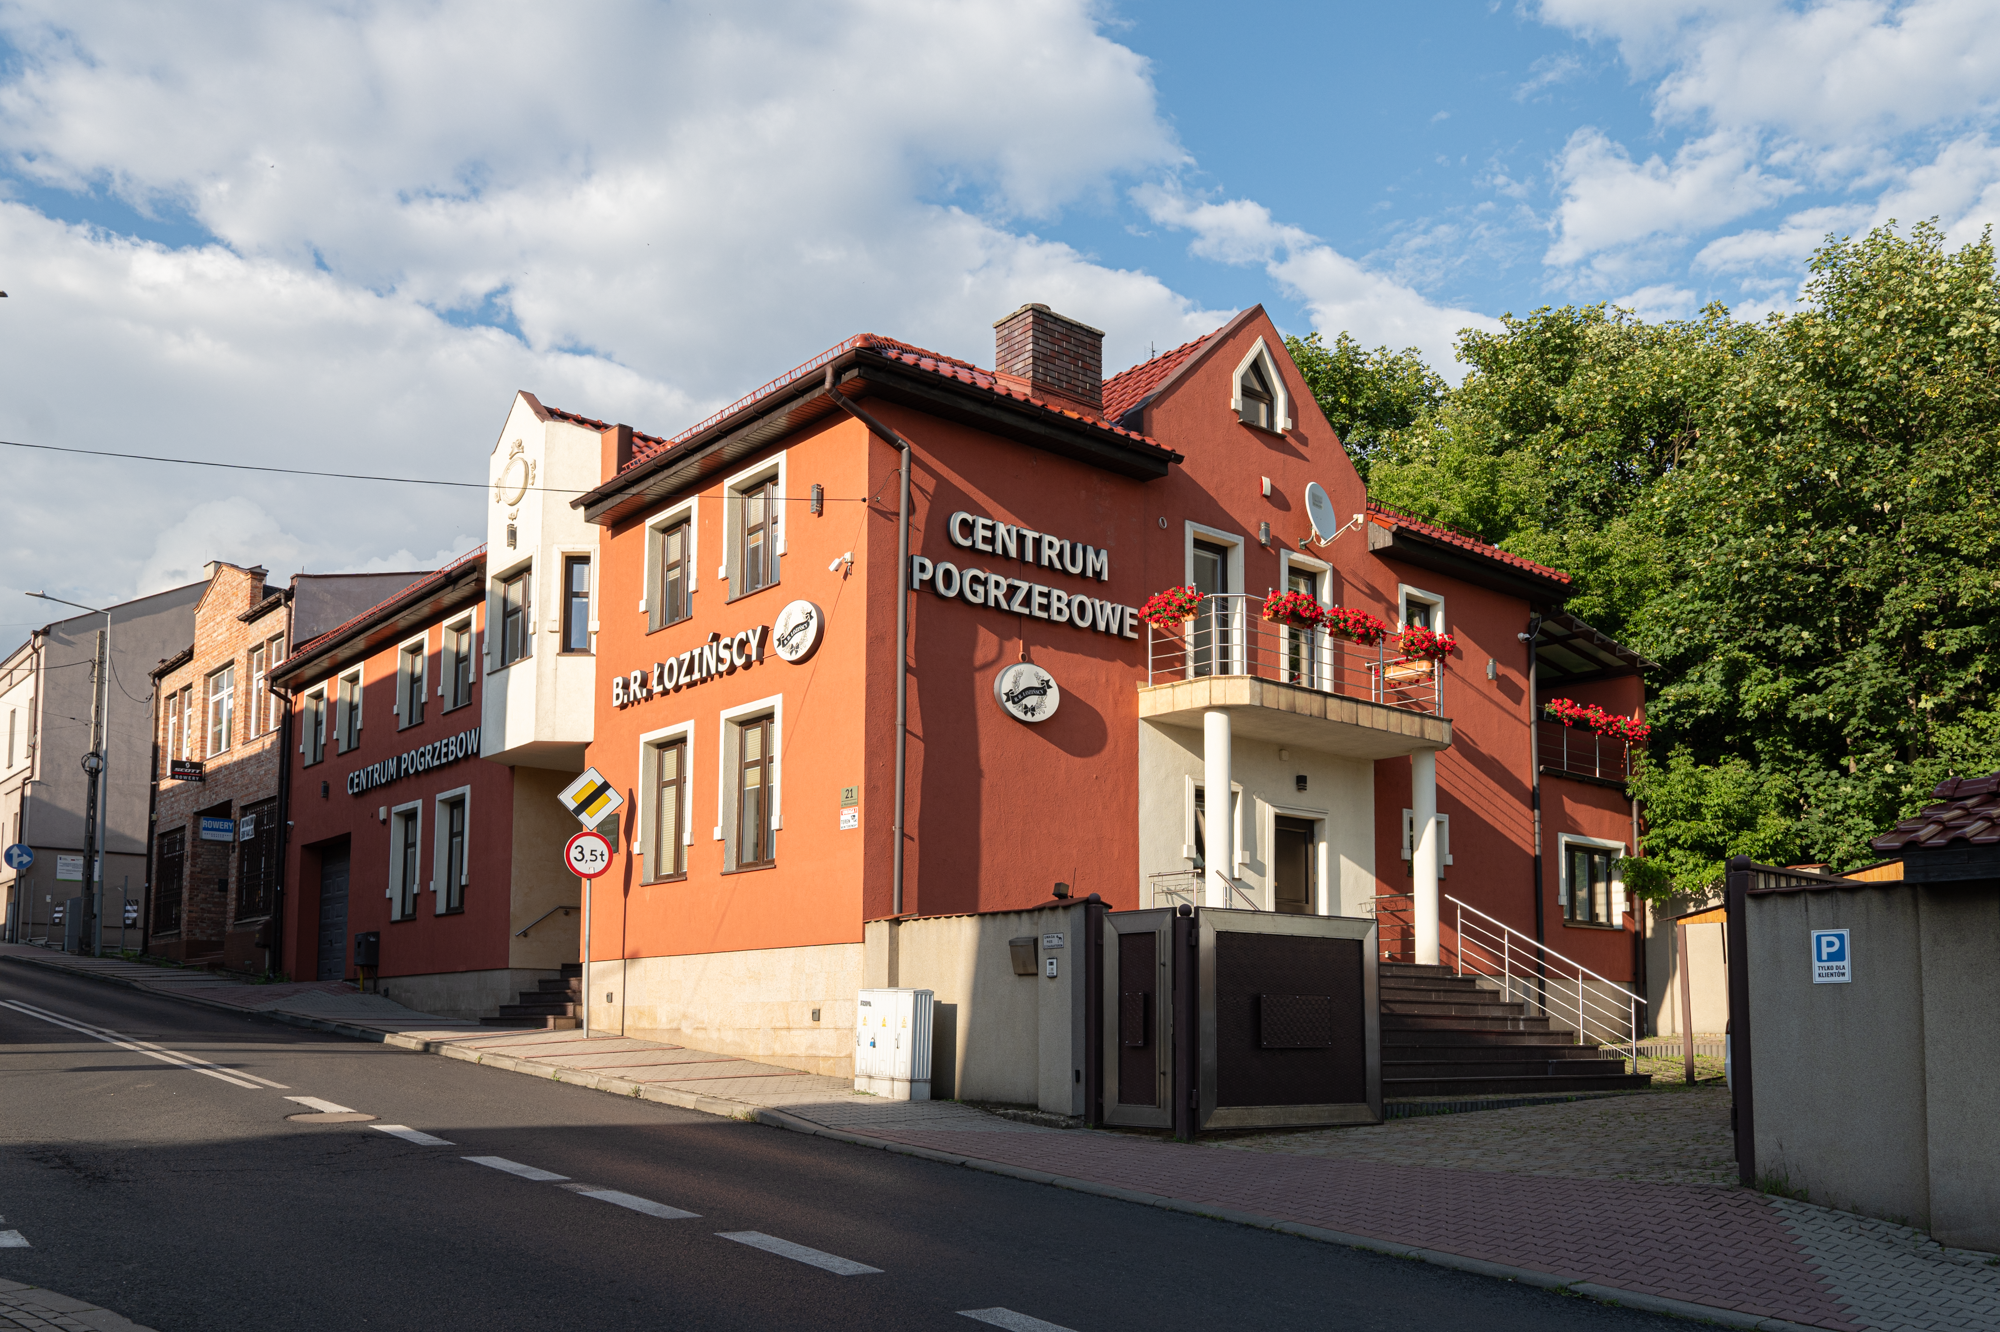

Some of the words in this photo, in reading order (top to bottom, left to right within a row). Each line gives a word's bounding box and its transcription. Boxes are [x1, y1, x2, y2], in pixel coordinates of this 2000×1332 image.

[949, 511, 1109, 581] CENTRUM
[911, 554, 1139, 639] POGRZEBOWE
[612, 669, 647, 707] B.R.
[651, 625, 766, 694] ŁOZIŃSCY
[347, 756, 397, 795] CENTRUM
[845, 788, 853, 799] 21
[202, 820, 234, 830] ROWERY
[1820, 935, 1840, 960] P
[1817, 970, 1846, 978] KLIENTÓW
